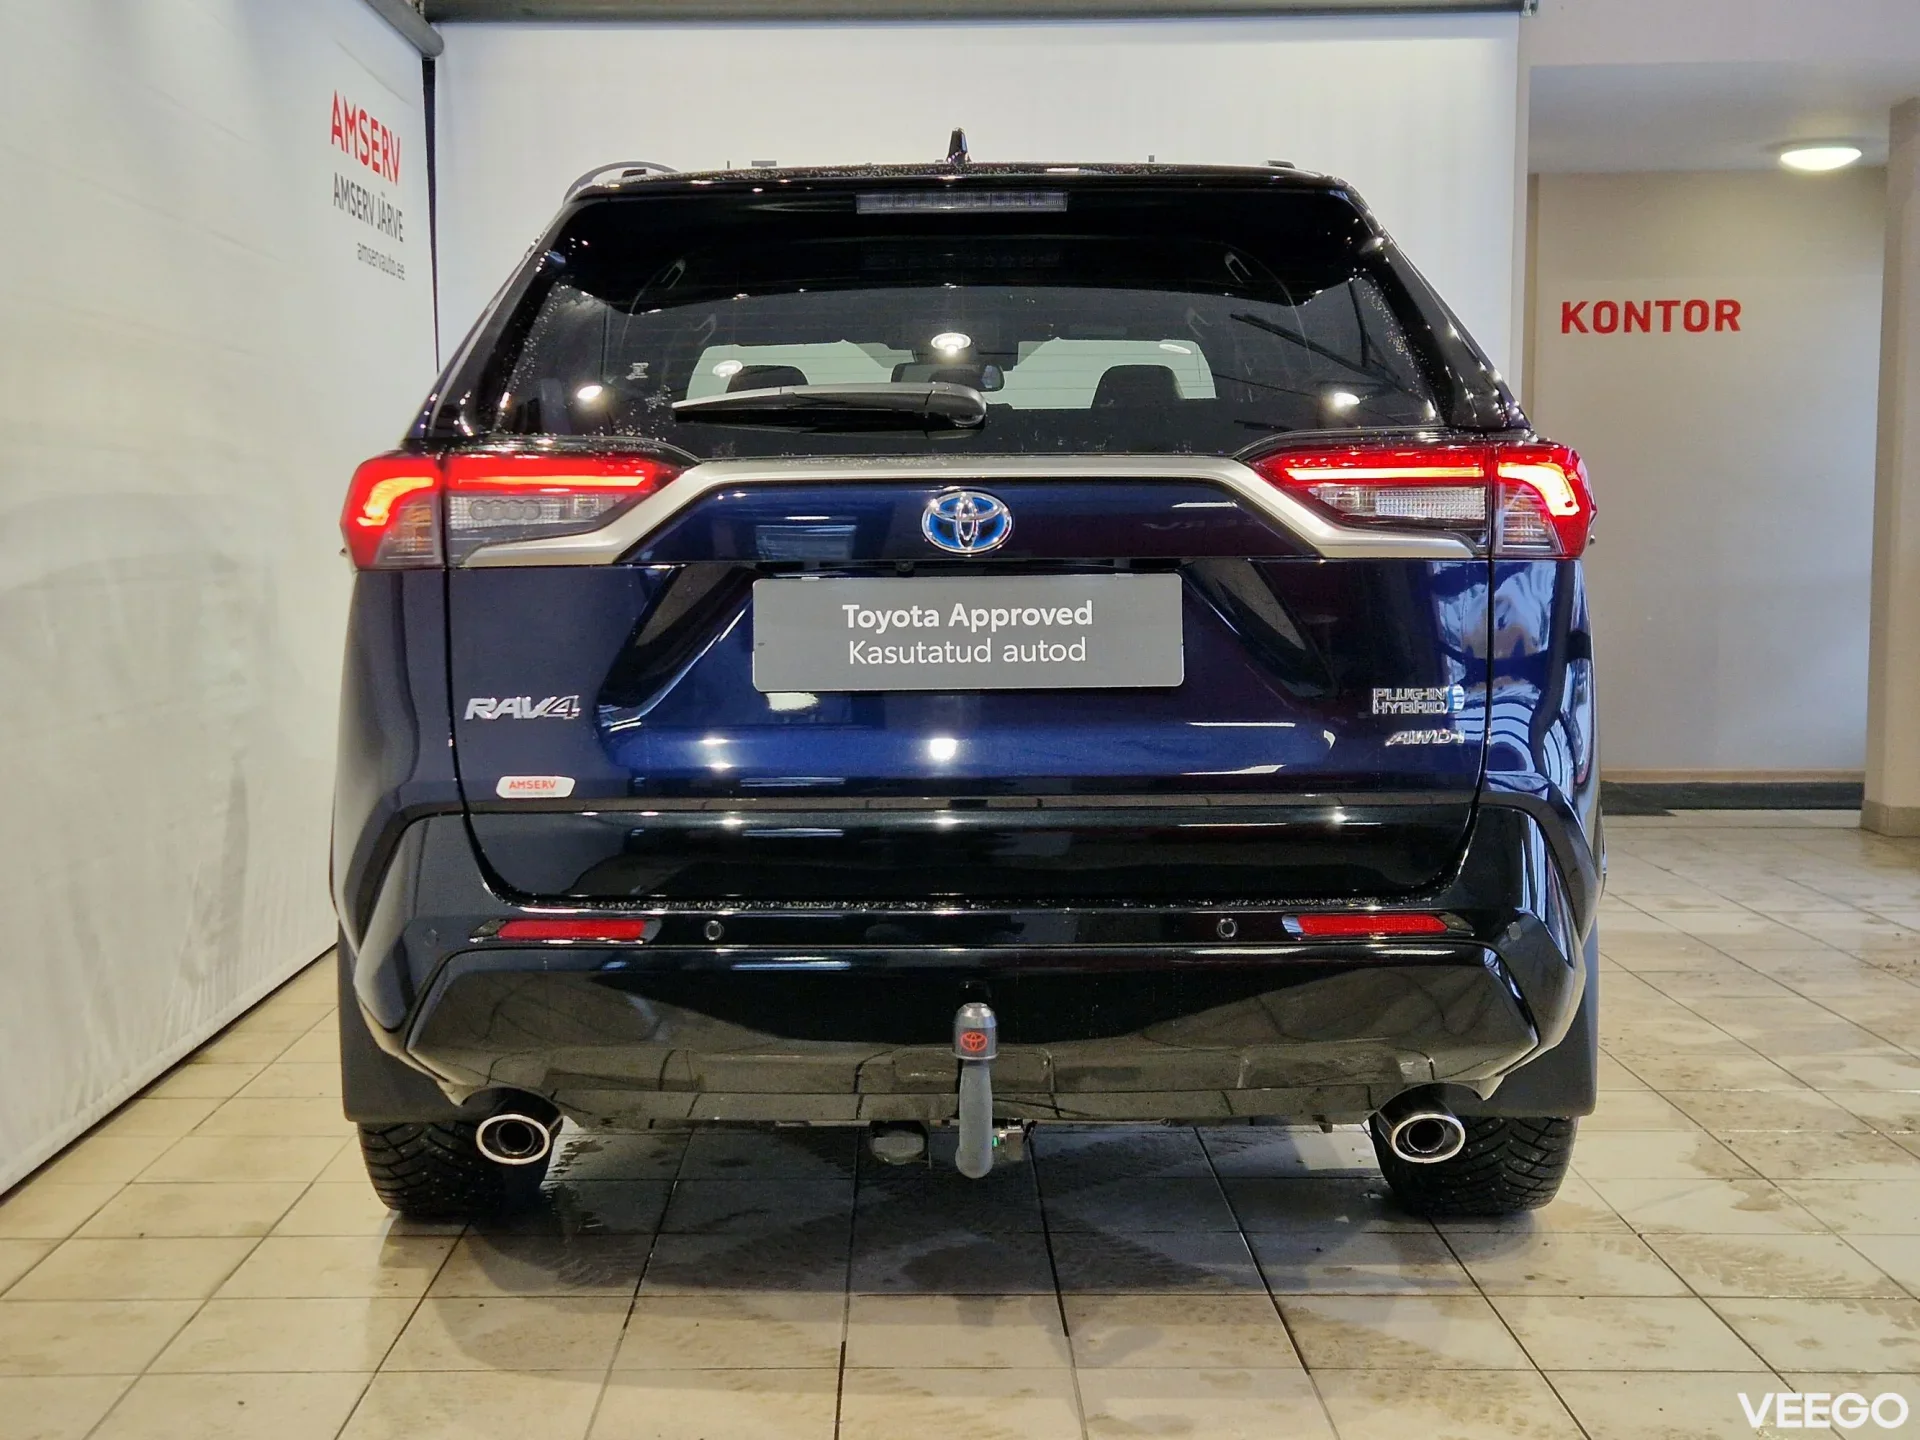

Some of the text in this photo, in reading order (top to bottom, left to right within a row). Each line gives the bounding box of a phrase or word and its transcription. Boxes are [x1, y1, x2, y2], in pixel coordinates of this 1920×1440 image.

[331, 89, 400, 185] AMSERV
[333, 172, 403, 242] AMSERV JÄRVE
[357, 242, 405, 280] amservauto.ee
[1561, 299, 1742, 334] KONTOR
[842, 601, 1093, 633] Toyota Approved
[849, 637, 1086, 665] Kasutatud autod
[464, 695, 580, 720] RAV4
[1372, 700, 1448, 714] HYBRID
[509, 780, 556, 789] AMSERV
